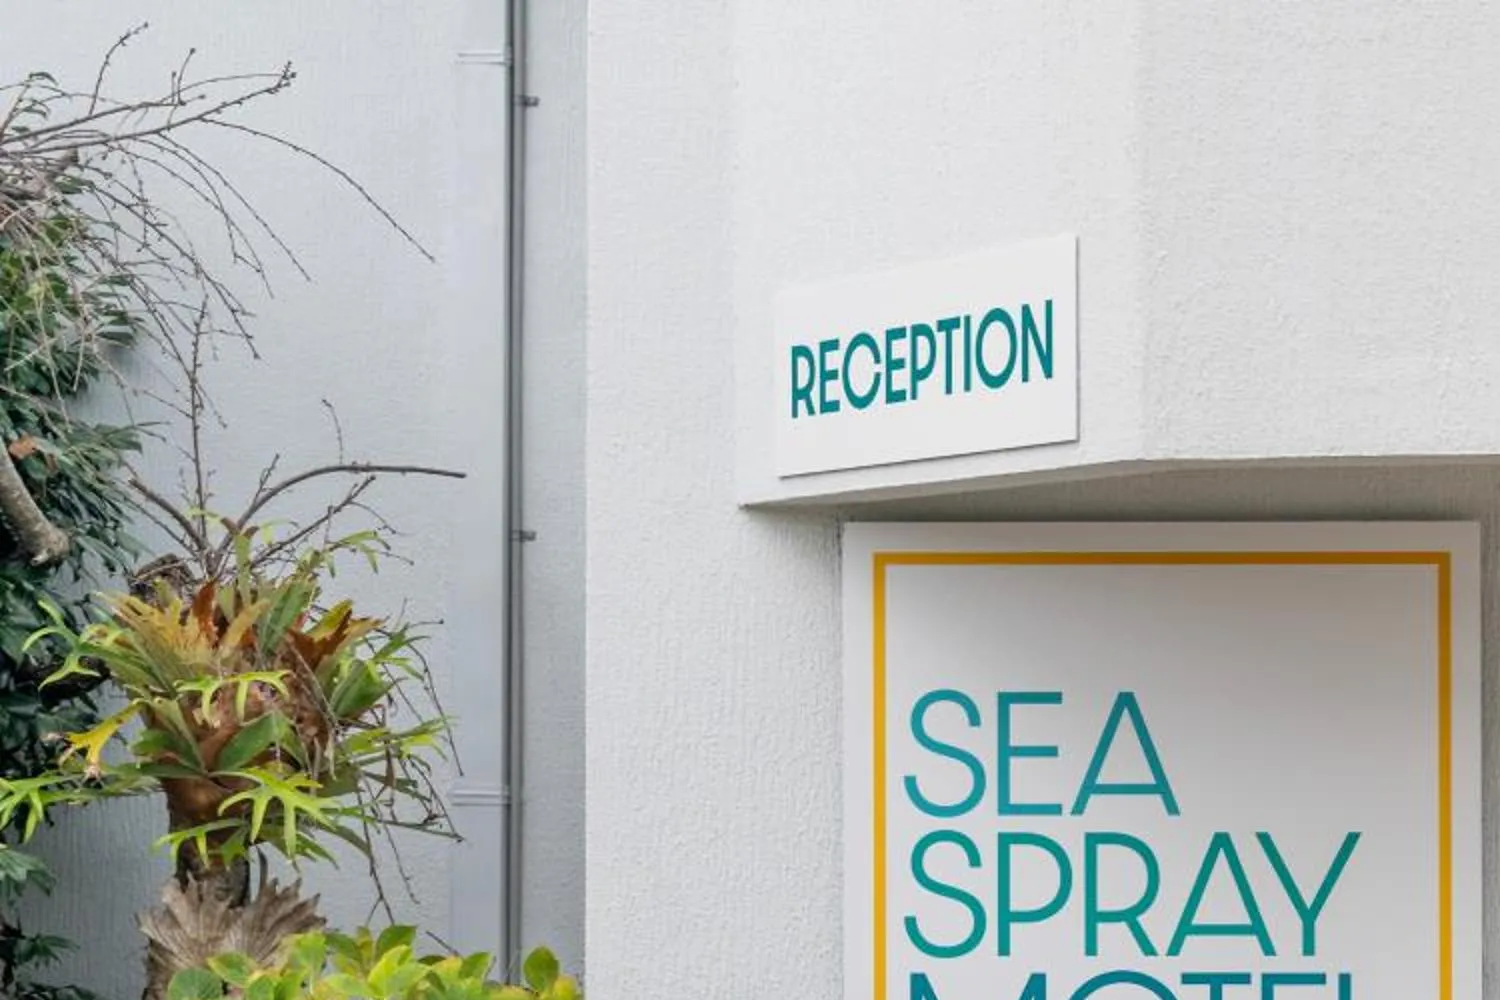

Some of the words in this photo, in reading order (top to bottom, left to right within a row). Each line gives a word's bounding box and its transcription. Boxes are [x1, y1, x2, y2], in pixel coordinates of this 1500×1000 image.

[791, 300, 1053, 418] RECEPTION
[903, 688, 1180, 819] SEA
[904, 829, 1361, 959] SPRAY
